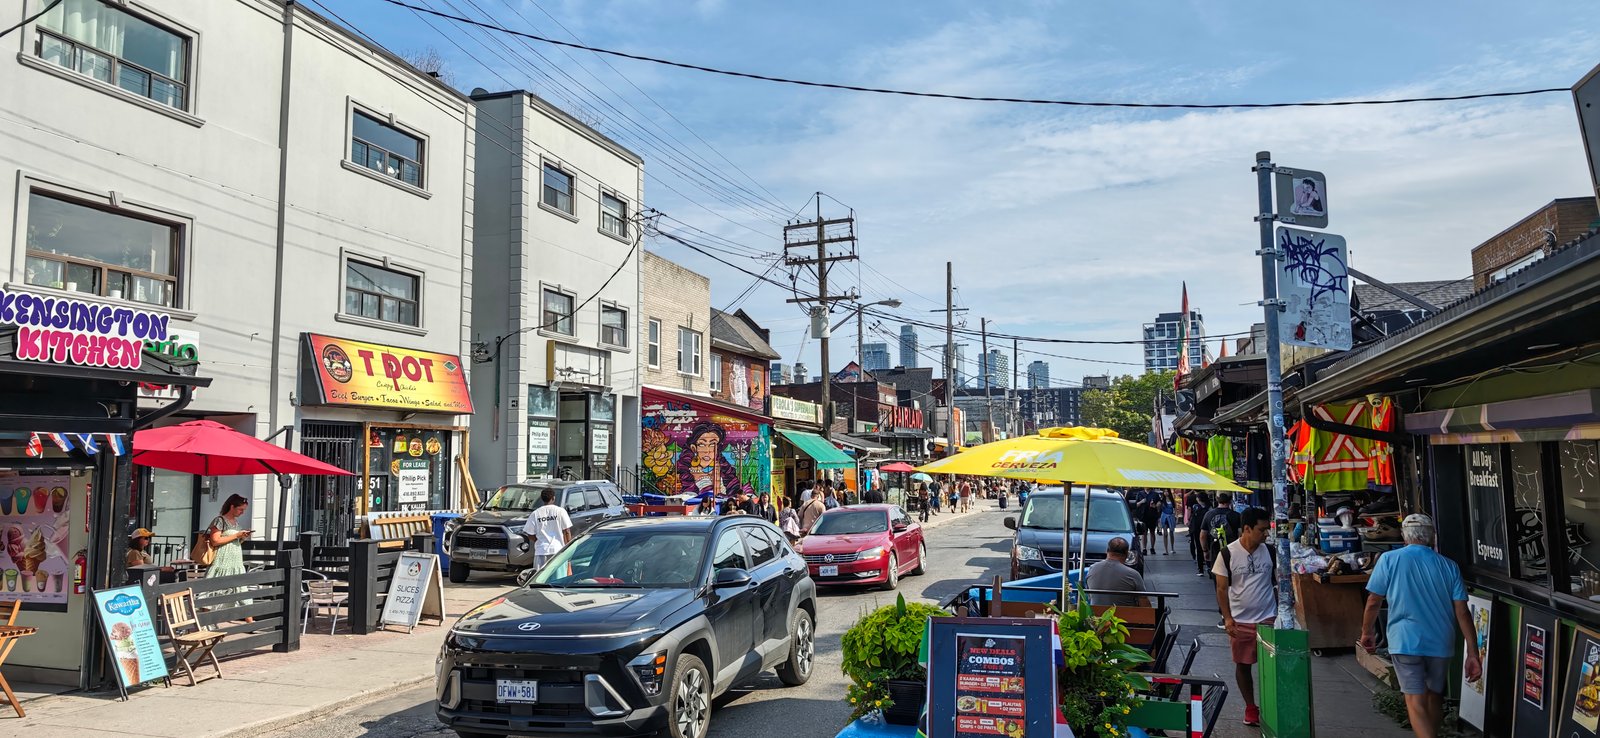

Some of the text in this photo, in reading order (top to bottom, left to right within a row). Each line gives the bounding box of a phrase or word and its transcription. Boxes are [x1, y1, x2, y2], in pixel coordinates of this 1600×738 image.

[0, 290, 170, 341] KENSINGTON
[18, 327, 142, 368] KITCHEN
[358, 349, 374, 376] T
[330, 389, 348, 400] Beef
[351, 391, 375, 403] Burger
[380, 394, 398, 404] Tacos
[400, 394, 421, 407] Wings
[425, 399, 442, 407] Salad
[894, 405, 924, 430] FAIRLAND
[991, 461, 1057, 469] CERVEZA
[1472, 451, 1492, 471] All Day
[1469, 471, 1499, 488] Breakfast
[1477, 539, 1503, 561] Espresso
[397, 584, 420, 594] SLICES
[107, 598, 140, 611] Kawartha
[395, 595, 415, 604] PIZZA
[969, 656, 1014, 665] COMBOS
[521, 686, 535, 699] 581
